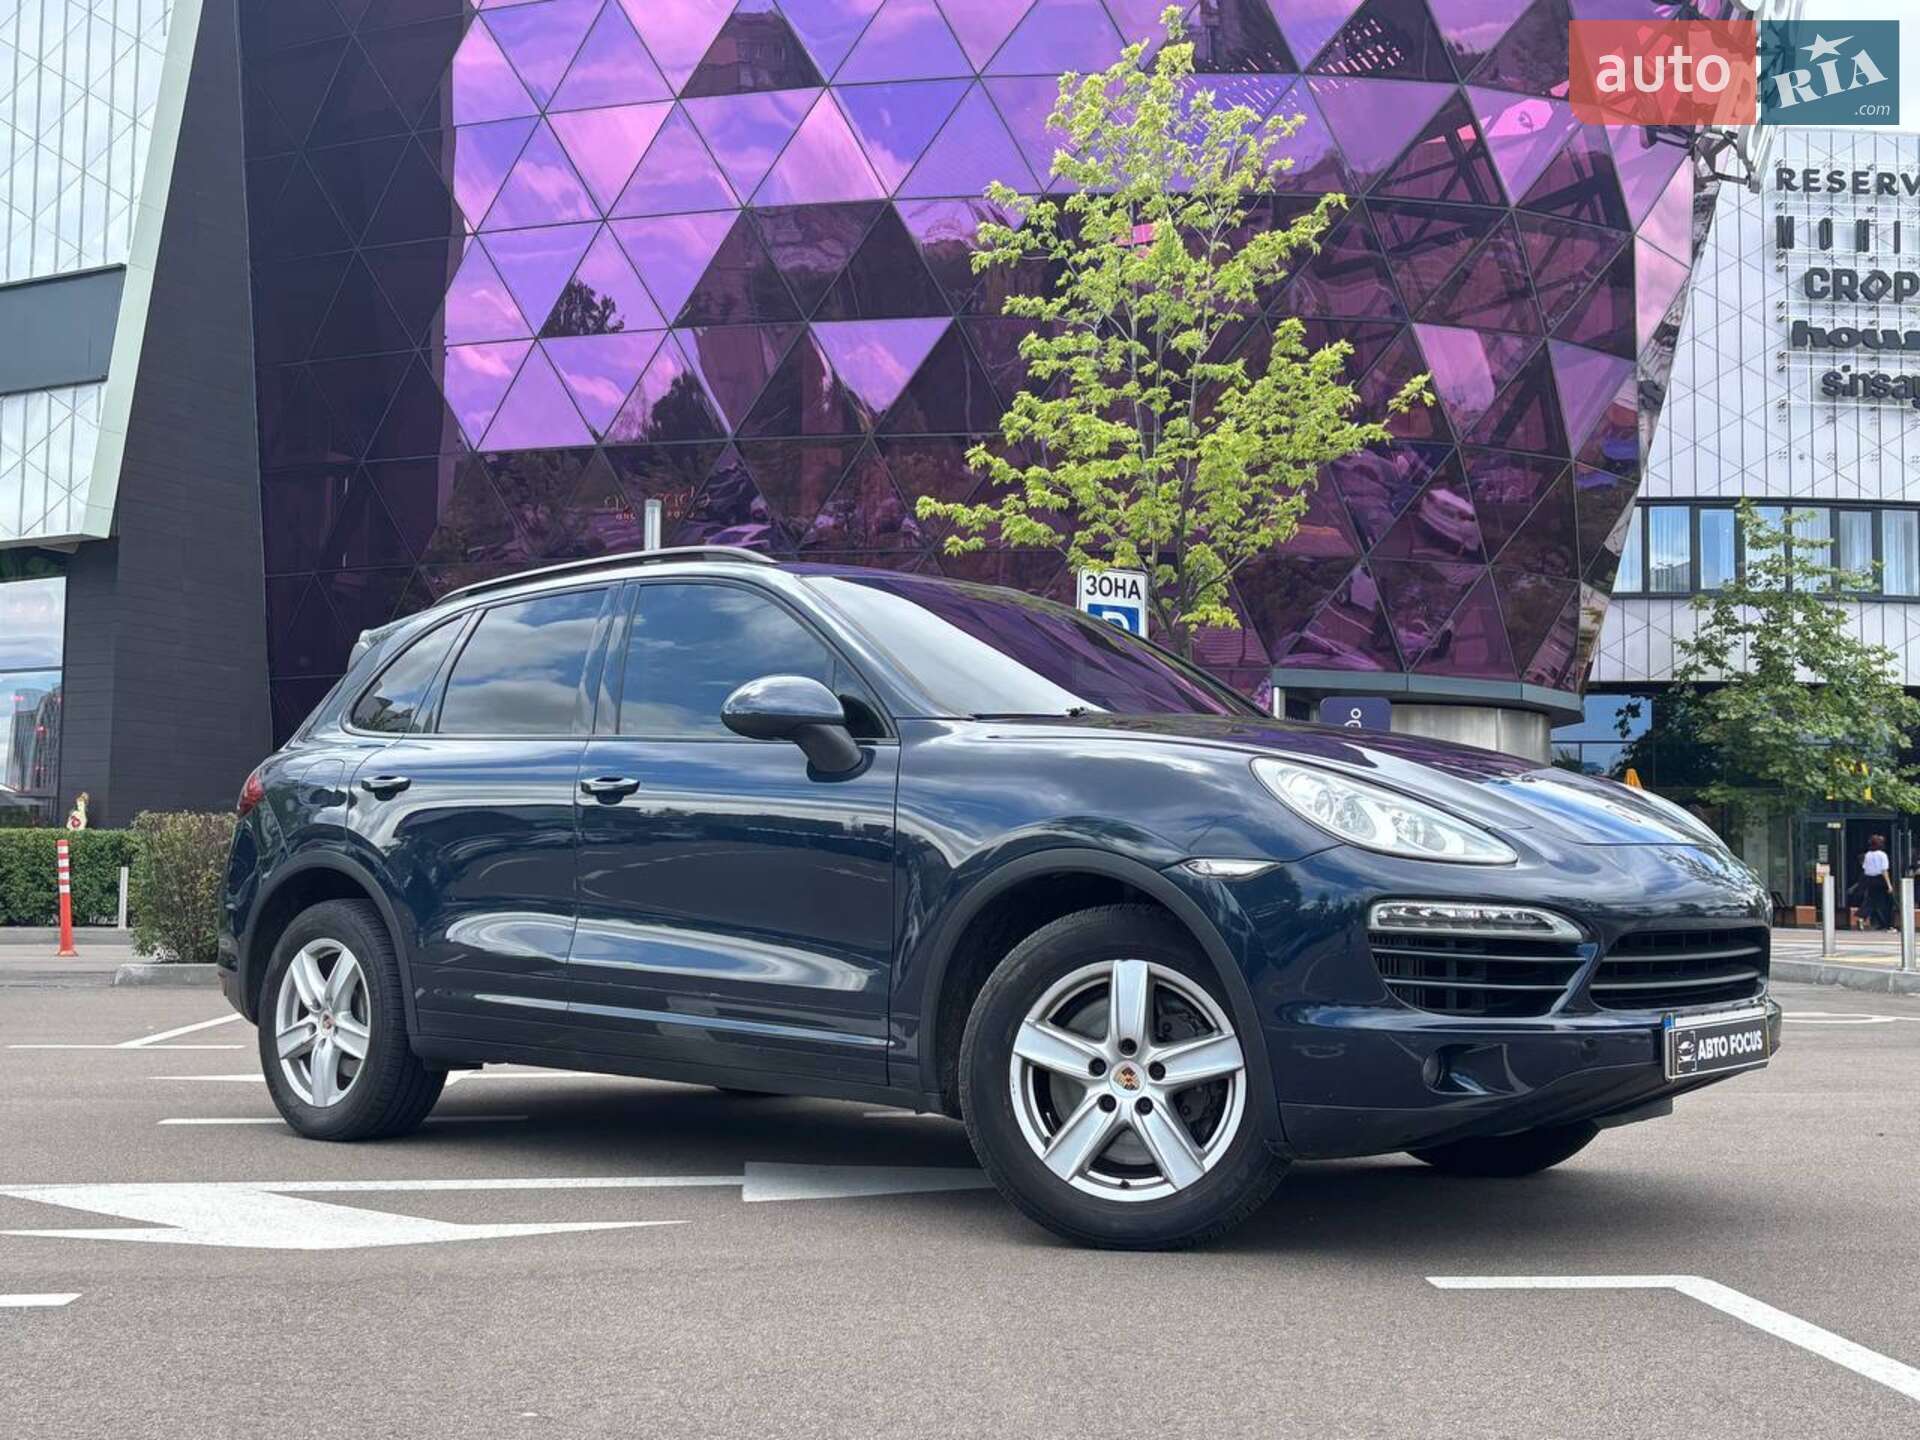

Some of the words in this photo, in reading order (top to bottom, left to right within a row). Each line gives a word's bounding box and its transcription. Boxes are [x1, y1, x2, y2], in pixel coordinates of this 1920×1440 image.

[1804, 267, 1919, 303] CROP
[1086, 575, 1141, 600] ЗОНА
[1730, 1030, 1763, 1055] FOCUS
